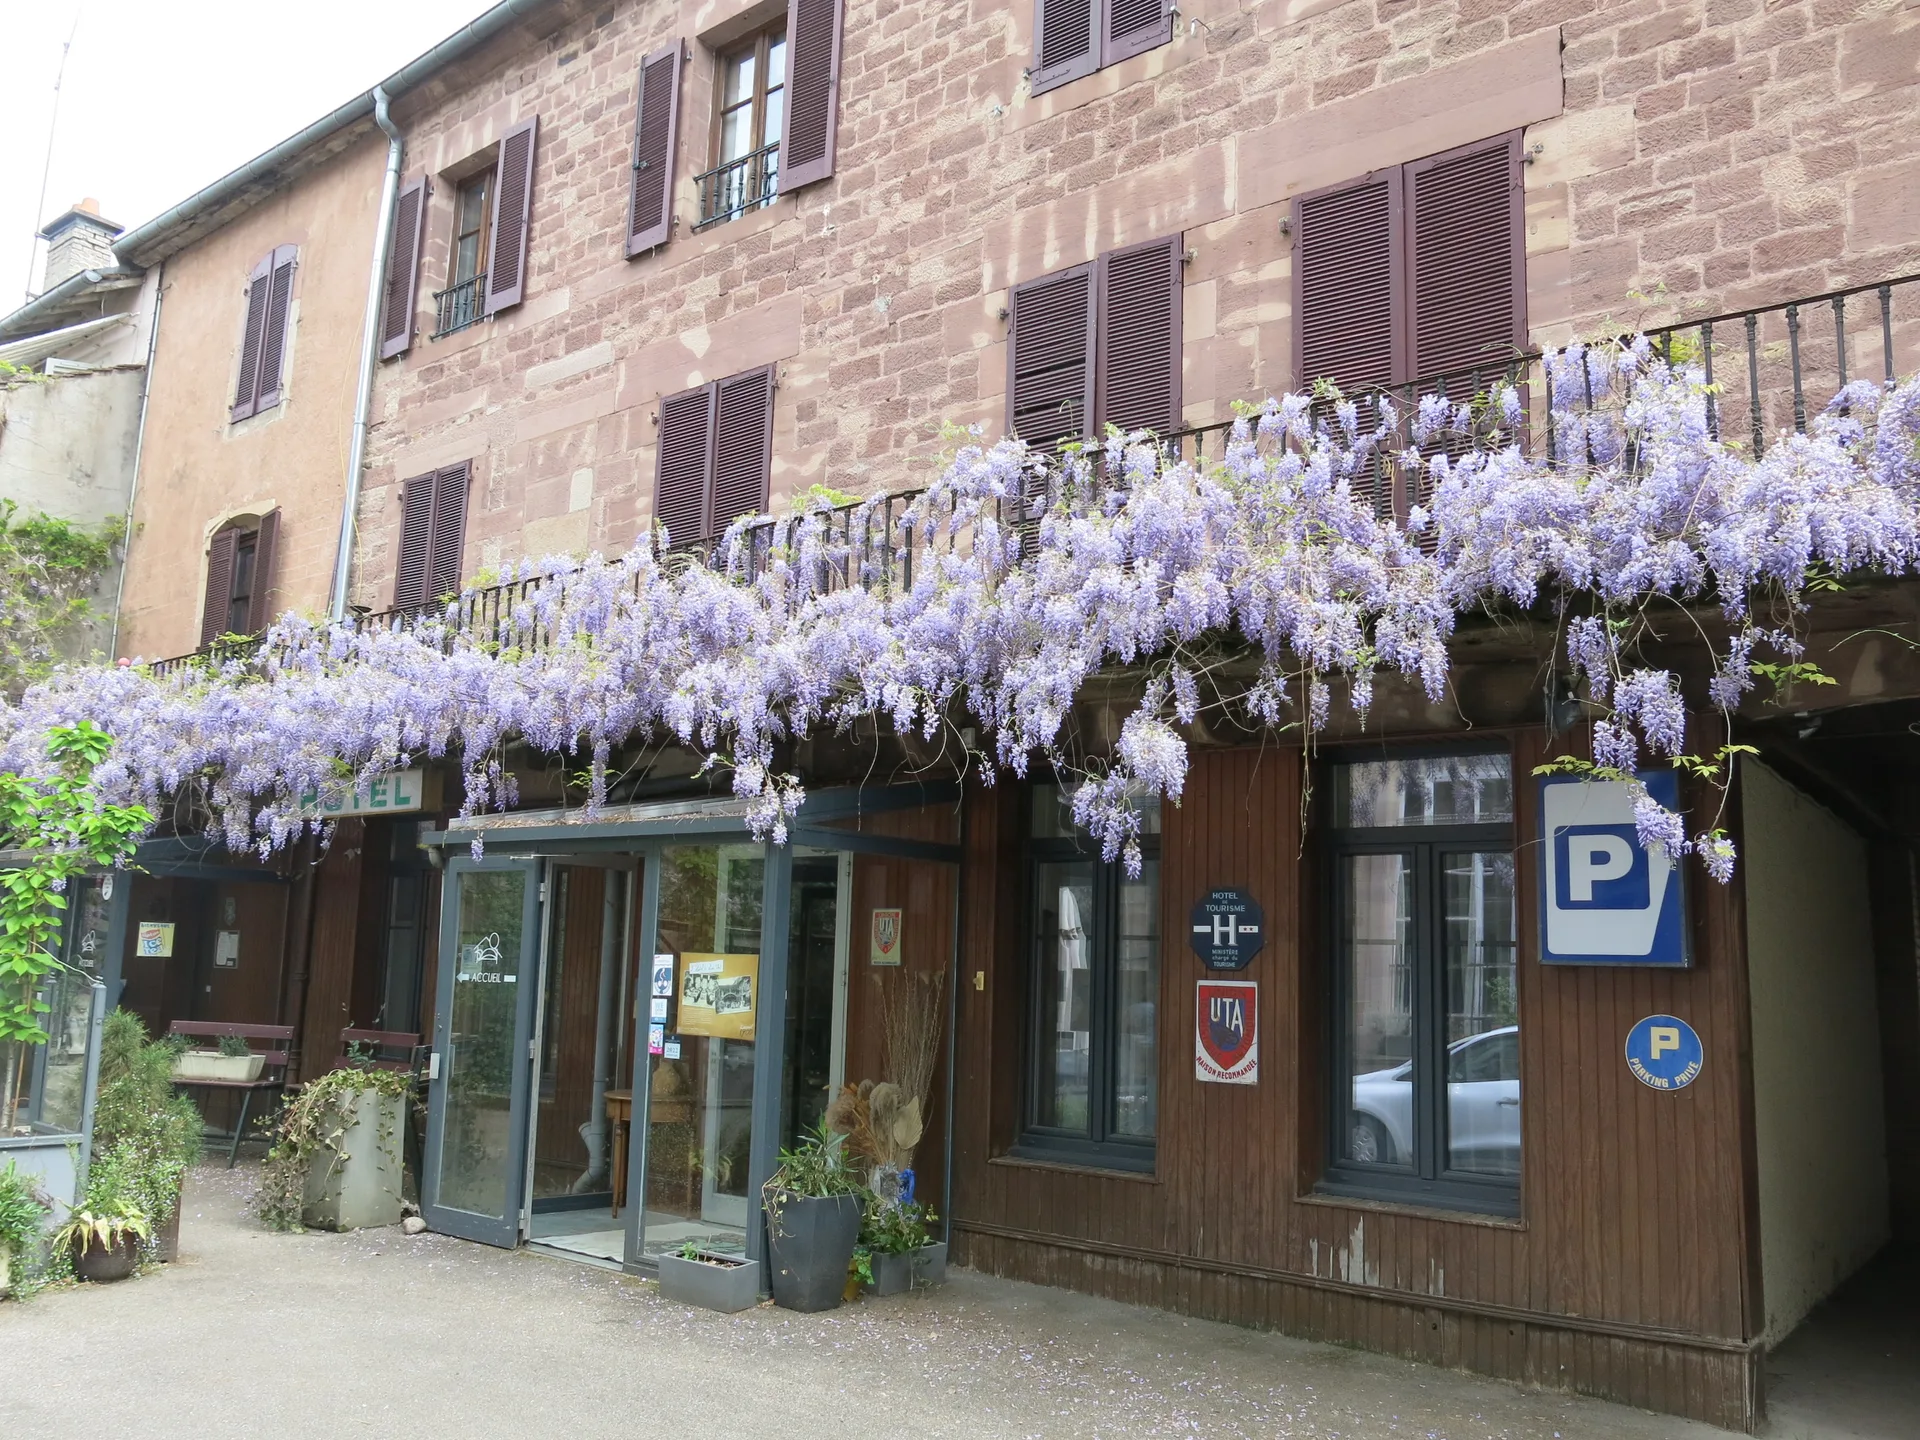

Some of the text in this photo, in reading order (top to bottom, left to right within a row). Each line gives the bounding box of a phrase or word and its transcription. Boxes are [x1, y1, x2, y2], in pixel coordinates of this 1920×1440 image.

[300, 776, 412, 813] HEL
[1569, 835, 1633, 901] P
[880, 918, 894, 938] UTA
[1213, 914, 1239, 947] H
[471, 973, 502, 983] ACCUEIL
[1211, 998, 1244, 1038] UTA
[1650, 1026, 1680, 1060] P
[1630, 1057, 1669, 1088] PARKING
